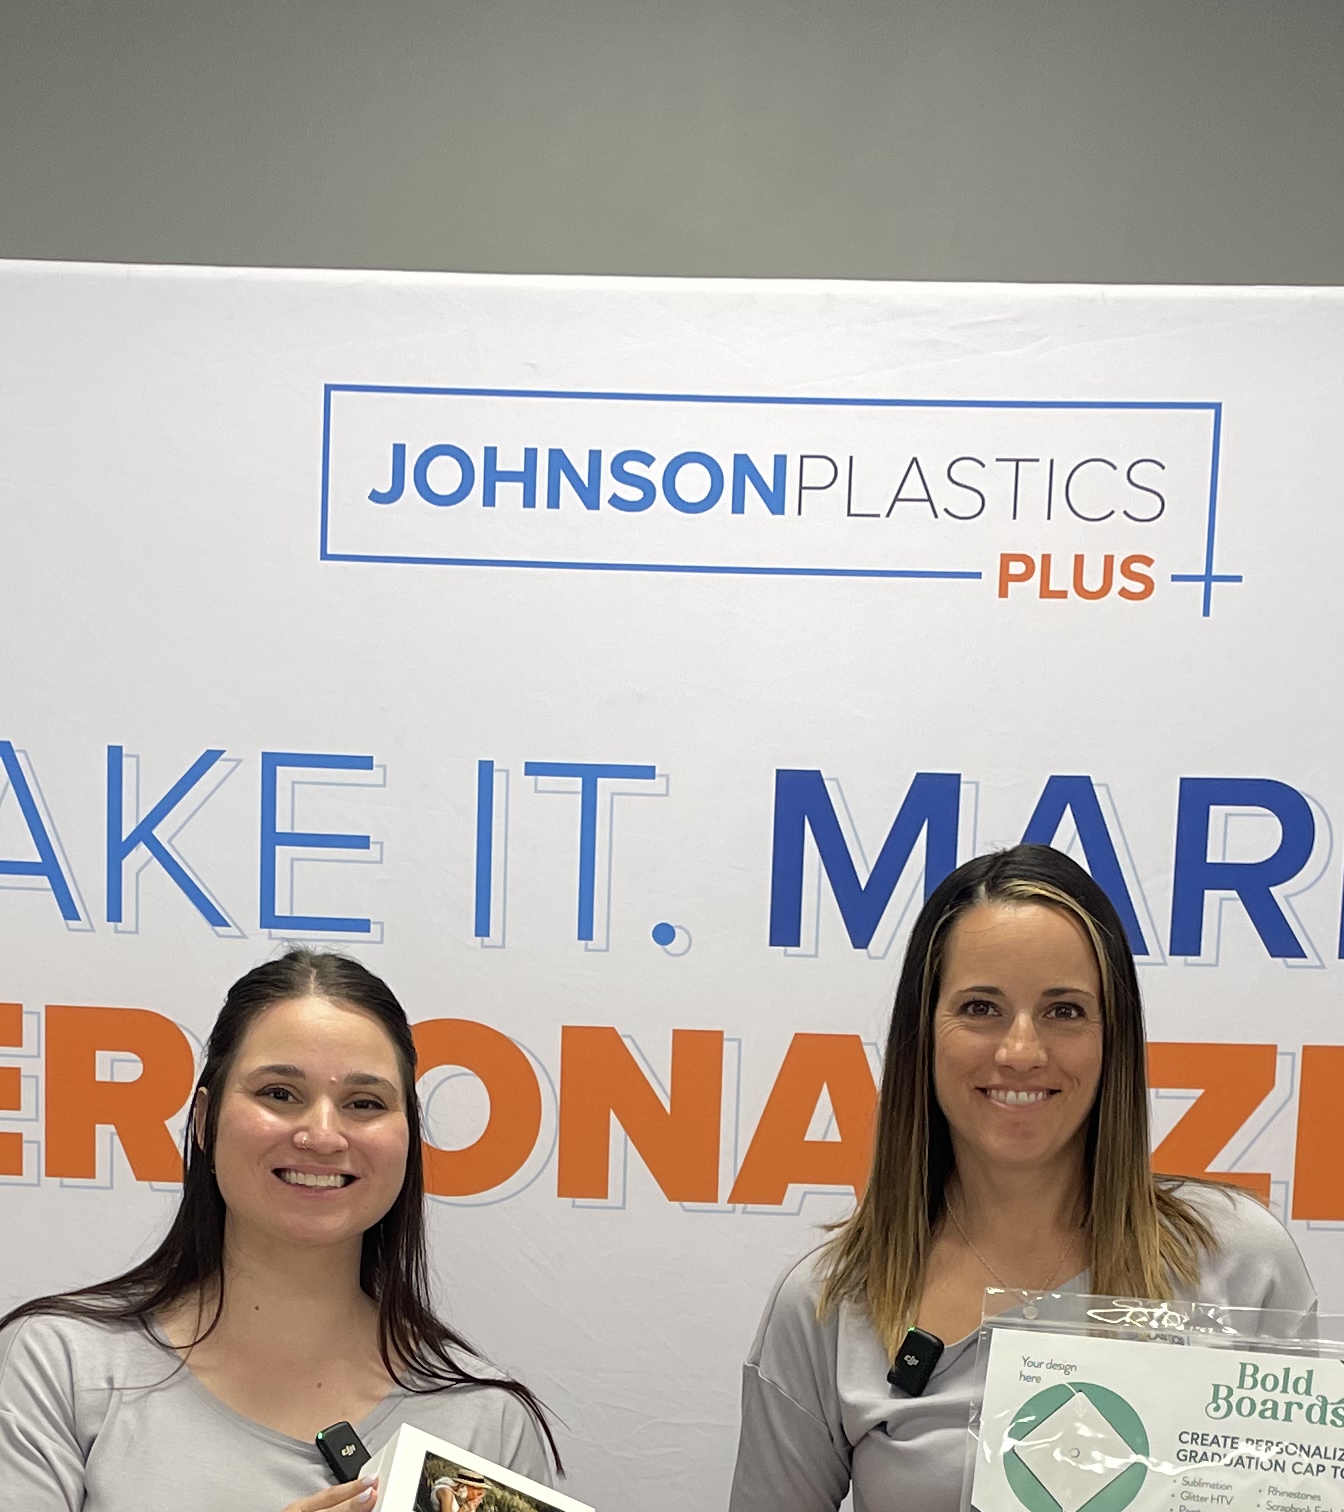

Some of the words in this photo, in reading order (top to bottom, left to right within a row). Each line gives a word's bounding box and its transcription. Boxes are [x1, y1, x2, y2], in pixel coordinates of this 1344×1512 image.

[997, 552, 1157, 601] PLUS
[474, 758, 677, 947] IT.
[1022, 1356, 1044, 1369] Your
[1045, 1359, 1077, 1376] design
[1018, 1370, 1043, 1384] here
[1236, 1361, 1314, 1397] Bold
[1178, 1431, 1240, 1450] CREATE
[1291, 1461, 1326, 1477] CAP
[1181, 1476, 1233, 1491] Sublimation
[1180, 1491, 1209, 1503] Glitter
[1210, 1494, 1234, 1506] HTV
[1267, 1486, 1321, 1502] Rhinestones
